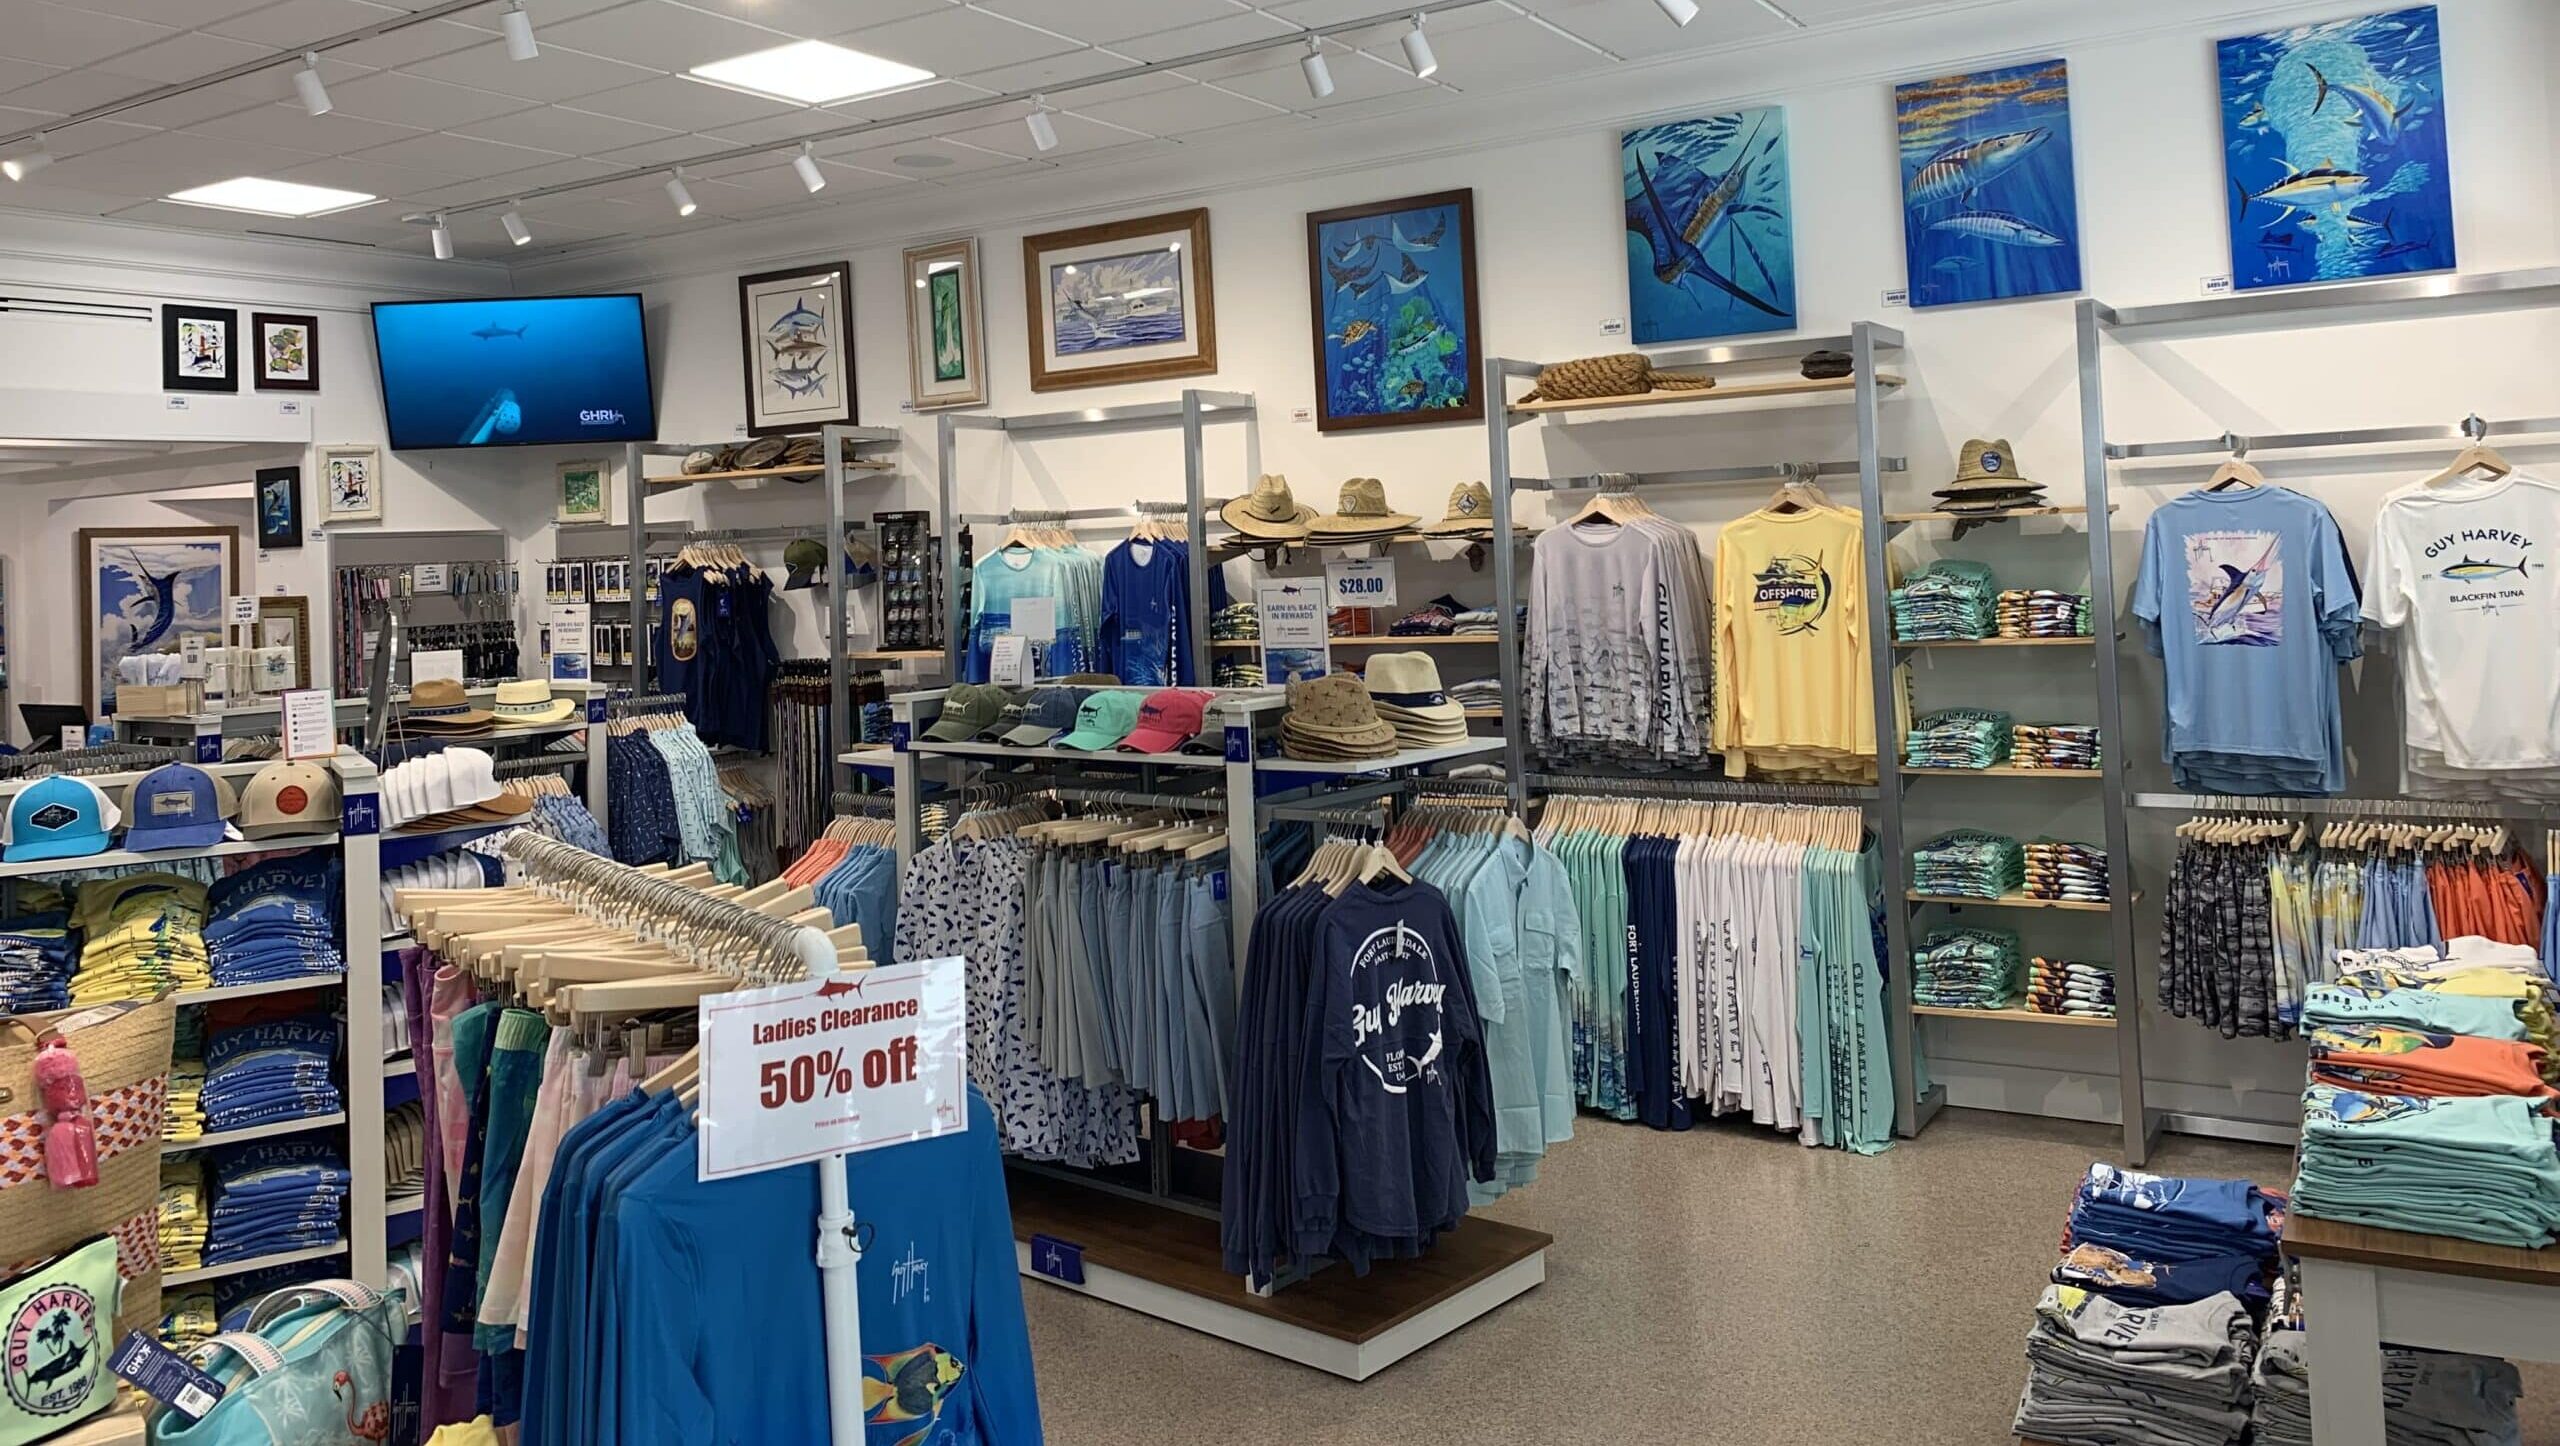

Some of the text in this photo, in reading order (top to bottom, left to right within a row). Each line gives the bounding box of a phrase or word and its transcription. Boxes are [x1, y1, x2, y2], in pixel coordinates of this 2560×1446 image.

[2424, 528, 2533, 558] GUY HARVEY
[1339, 577, 1384, 595] $28.00
[1759, 587, 1818, 600] OFFSHORE
[2449, 589, 2525, 603] BLACKFIN TUNA
[1267, 604, 1286, 612] EARN
[1298, 603, 1318, 611] BACK
[1271, 611, 1314, 620] IN REWARDS
[1627, 925, 1637, 953] FORT
[1359, 944, 1377, 968] FORT
[1386, 977, 1446, 1027] Harvey
[752, 998, 918, 1045] Ladies Clearance
[760, 1035, 919, 1109] 50% off
[12, 1293, 92, 1367] GUY HARVEY
